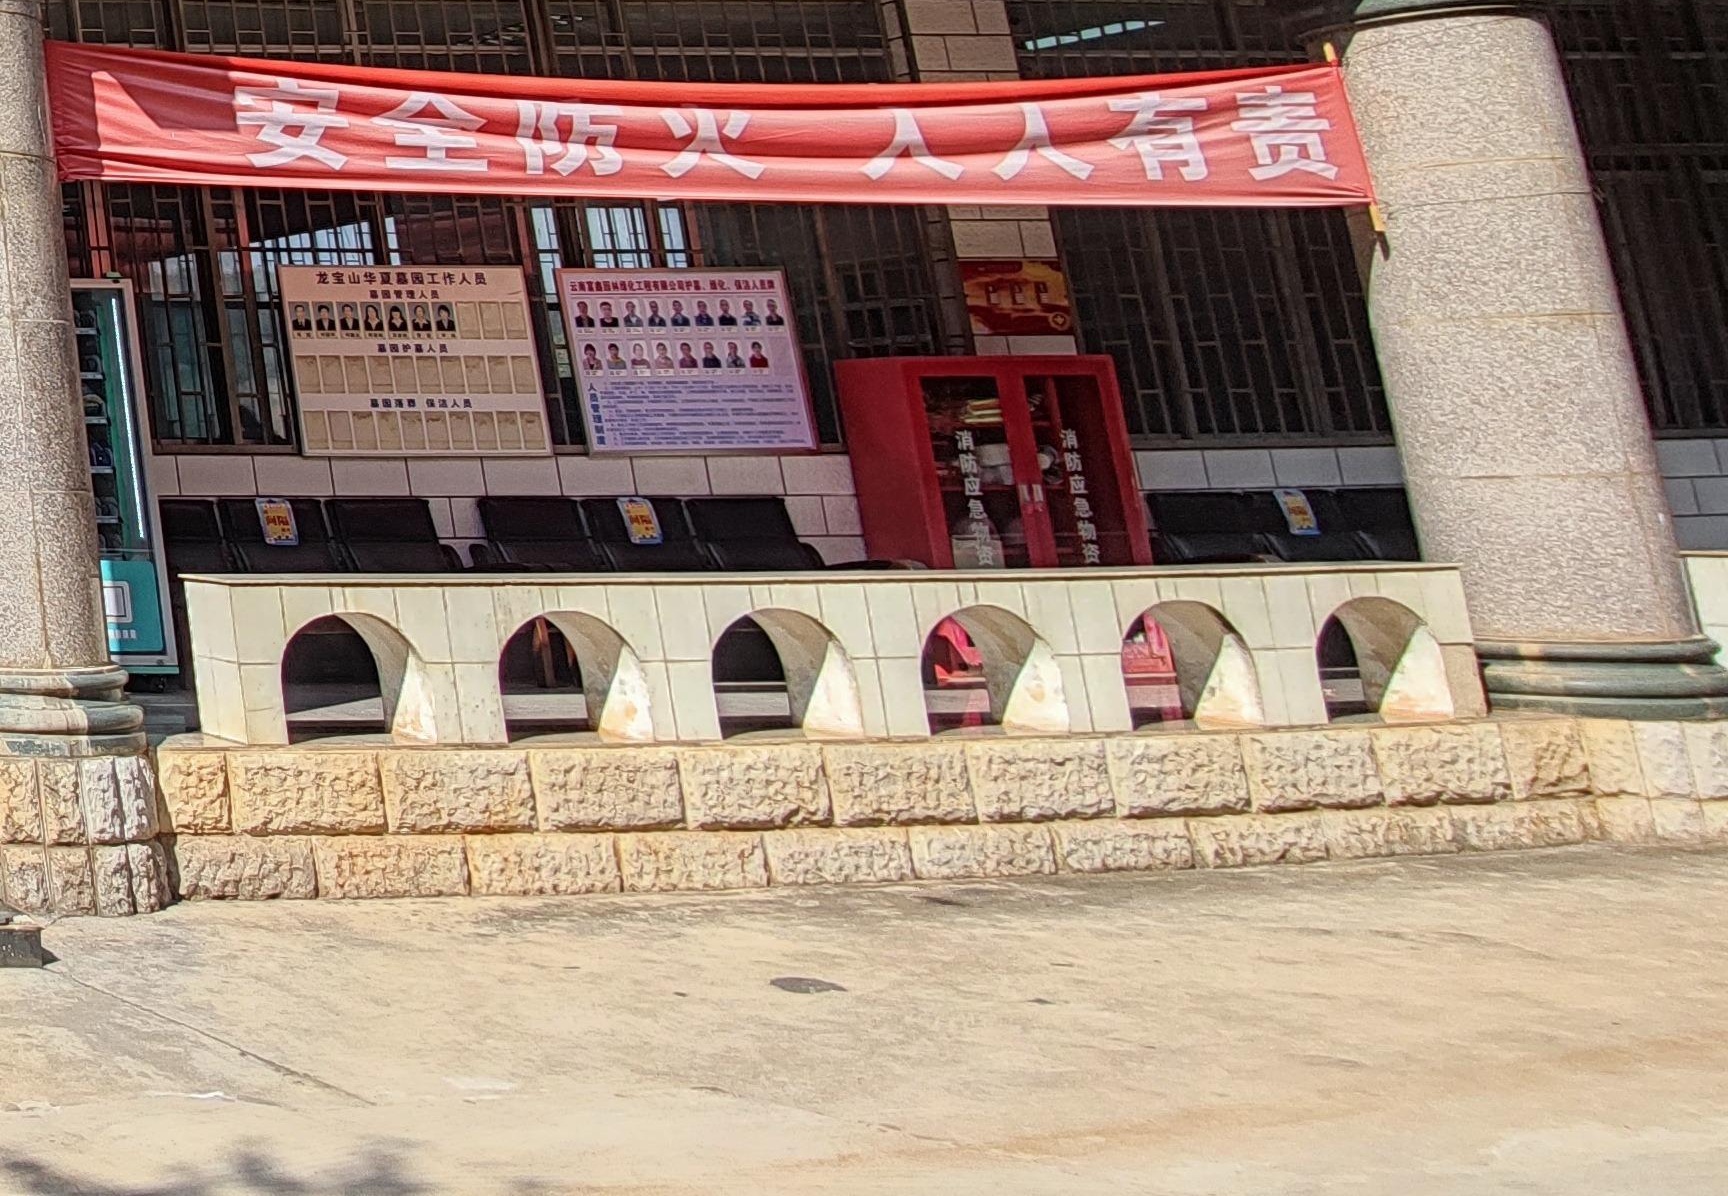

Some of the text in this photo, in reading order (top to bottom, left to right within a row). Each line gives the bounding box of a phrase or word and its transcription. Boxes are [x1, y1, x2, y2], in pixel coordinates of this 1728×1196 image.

[231, 78, 1340, 182] 安全防火 人人有责
[315, 271, 488, 286] 龙宝山华夏墓园工作人员
[369, 289, 440, 300] 墓园管理人员
[954, 430, 994, 566] 消防应急物资
[1061, 428, 1101, 564] 消防应急物资
